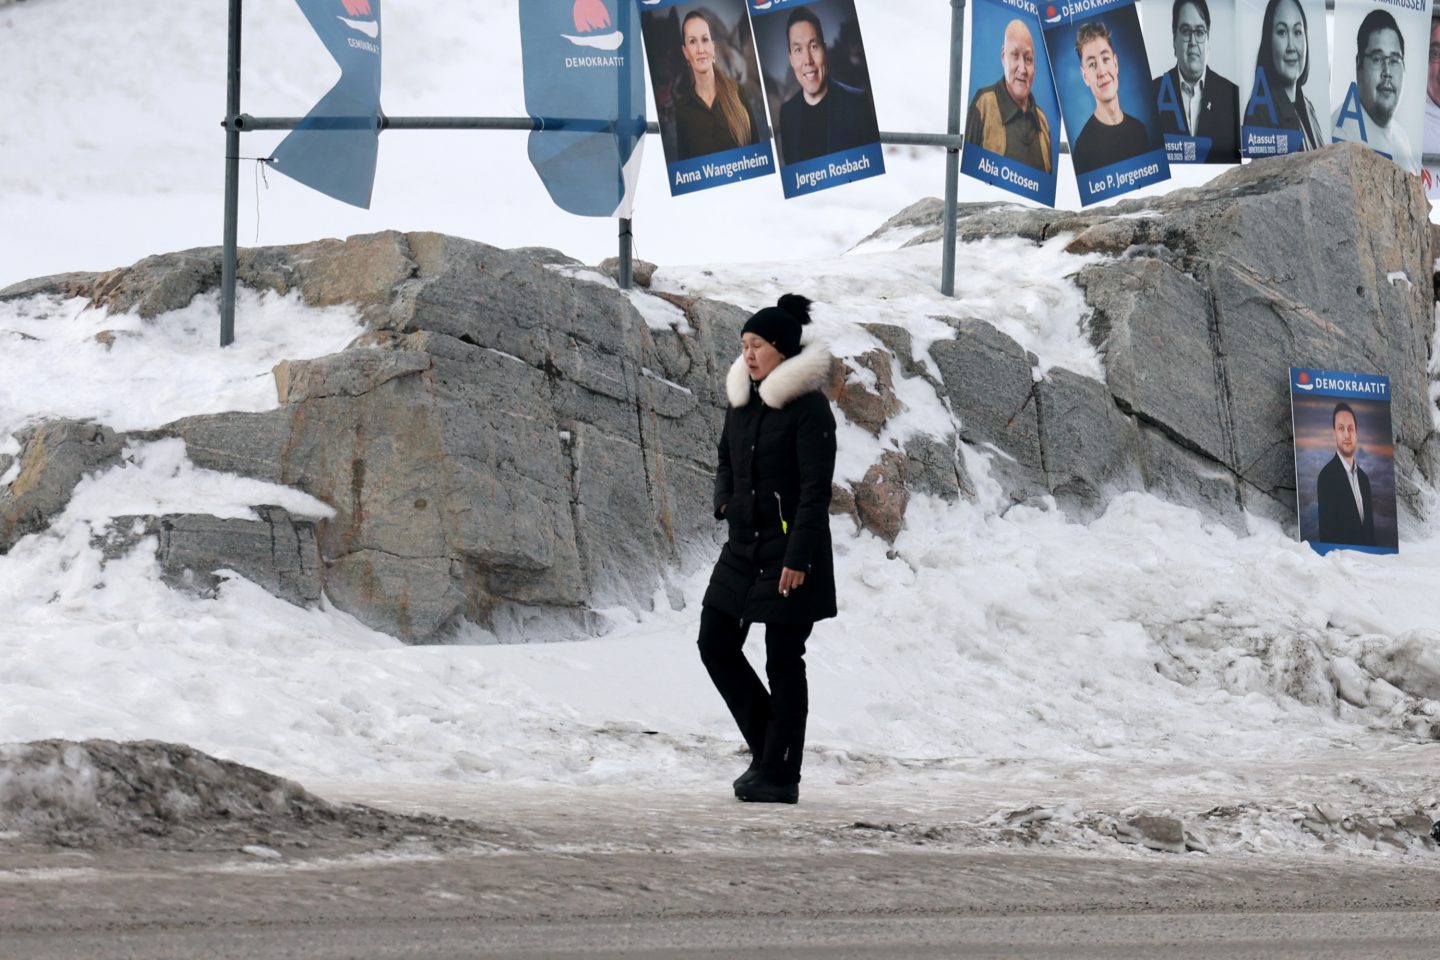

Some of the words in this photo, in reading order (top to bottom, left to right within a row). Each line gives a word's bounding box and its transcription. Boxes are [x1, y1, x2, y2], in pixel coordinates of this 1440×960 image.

[565, 56, 625, 68] DEMOKRAATIT
[1248, 133, 1276, 145] Atassut
[675, 171, 701, 185] Anna
[702, 153, 769, 178] Wangenheim
[795, 169, 828, 190] Jørgen
[828, 155, 870, 177] Rosbach
[978, 157, 999, 176] Abia
[1000, 167, 1039, 192] Ottosen
[1088, 180, 1106, 194] Leo
[1107, 174, 1116, 189] P.
[1116, 163, 1159, 189] Jørgensen
[1315, 378, 1386, 394] DEMOKRAATIT
